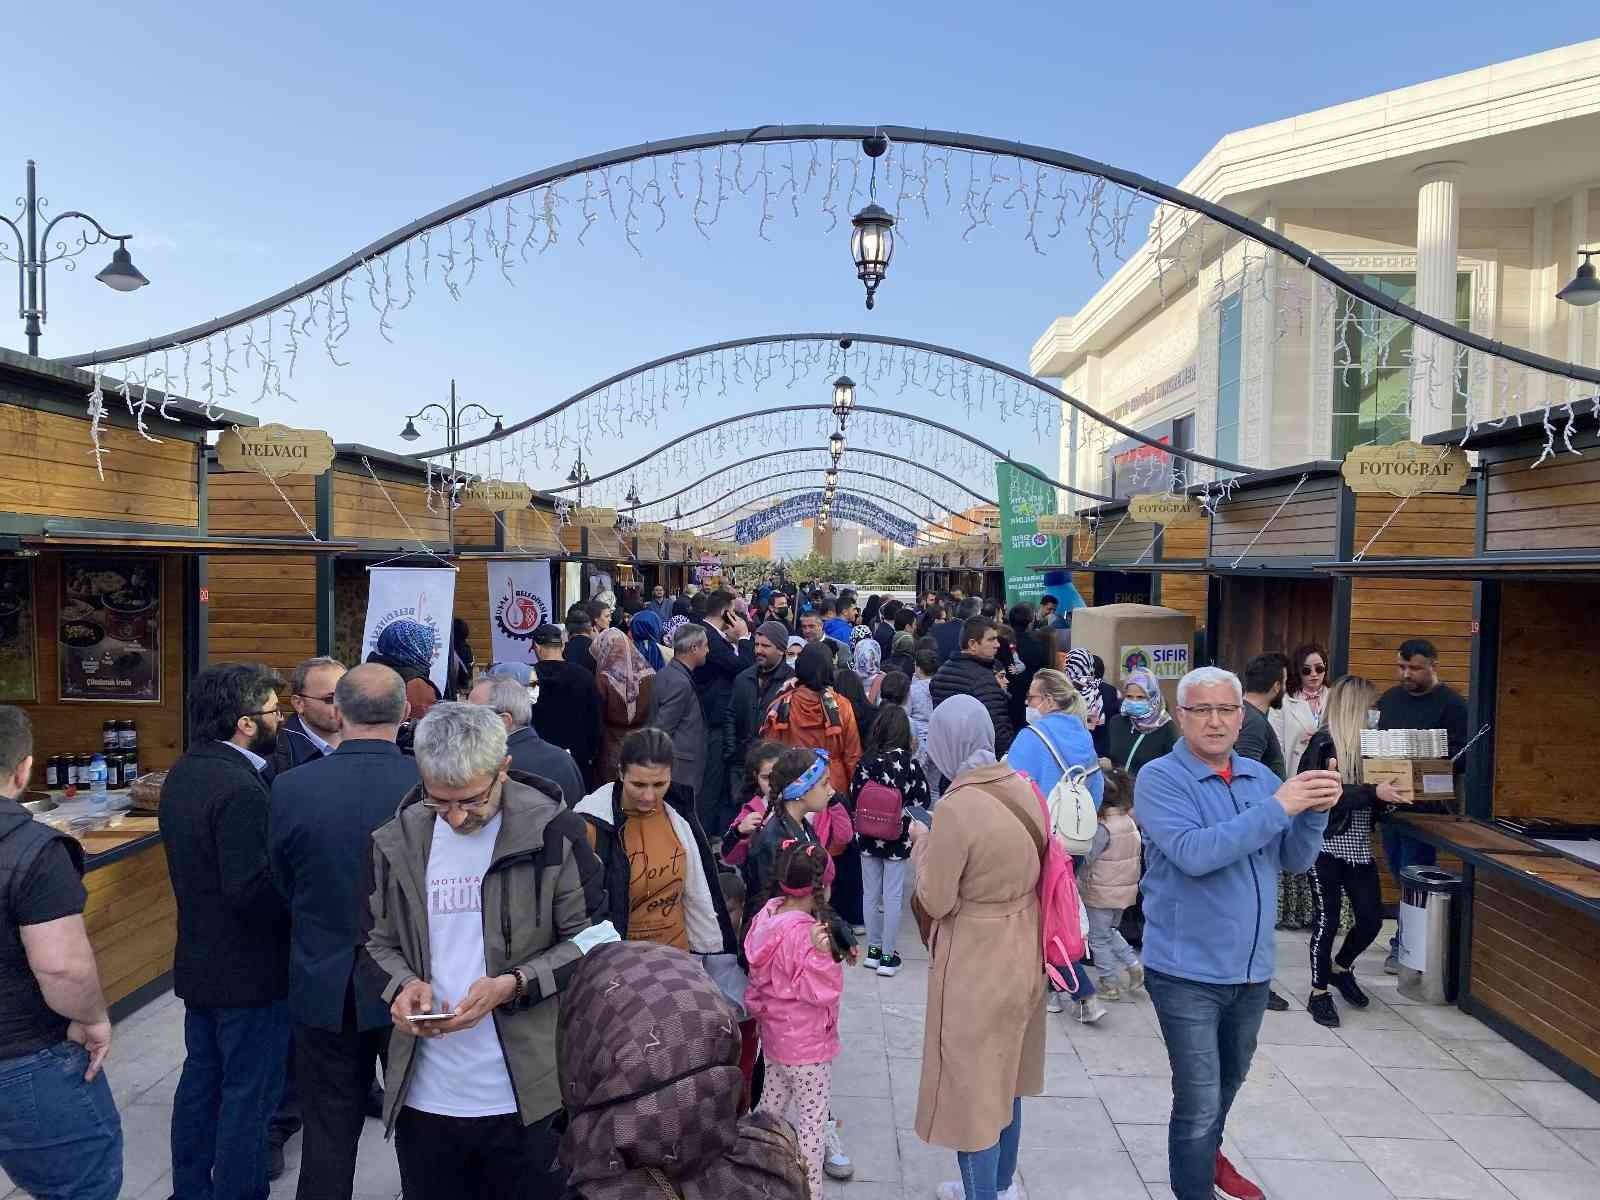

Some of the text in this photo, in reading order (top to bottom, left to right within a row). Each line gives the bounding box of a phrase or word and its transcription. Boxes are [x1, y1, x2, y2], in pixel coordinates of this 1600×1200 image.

[241, 443, 308, 458] HELVACI
[1359, 461, 1455, 476] FOTOĞRAF
[1153, 649, 1187, 662] SIFIR
[1154, 662, 1187, 675] ATIK
